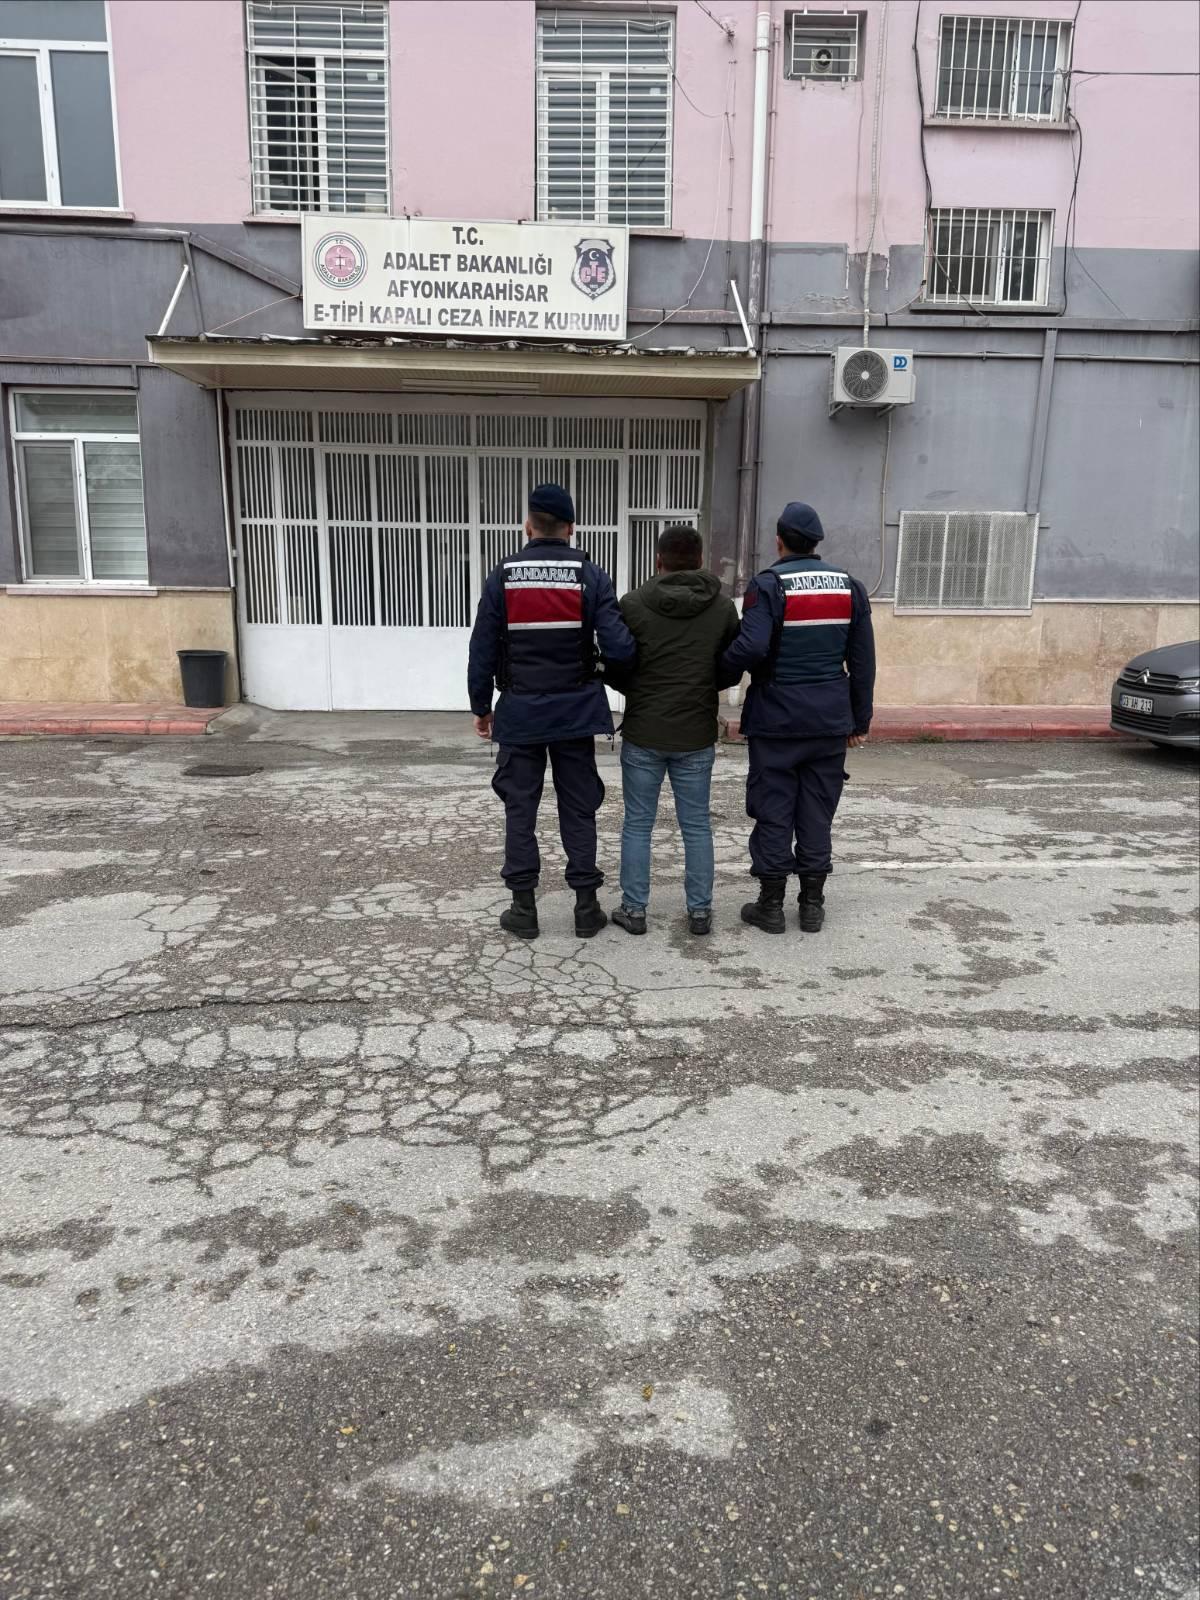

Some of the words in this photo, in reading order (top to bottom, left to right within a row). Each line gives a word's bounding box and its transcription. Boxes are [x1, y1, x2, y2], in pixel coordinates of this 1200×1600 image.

[452, 226, 484, 246] T.C.
[383, 252, 451, 272] ADALET
[456, 253, 552, 276] BAKANLIĞI
[387, 279, 548, 302] AFYONKARAHİSAR
[314, 300, 364, 323] E-TİPİ
[370, 305, 432, 326] KAPALI
[437, 308, 484, 327] CEZA
[489, 305, 539, 329] İNFAZ
[544, 311, 620, 332] KURUMU
[508, 567, 577, 582] JANDARMA
[790, 575, 846, 590] JANDARMA
